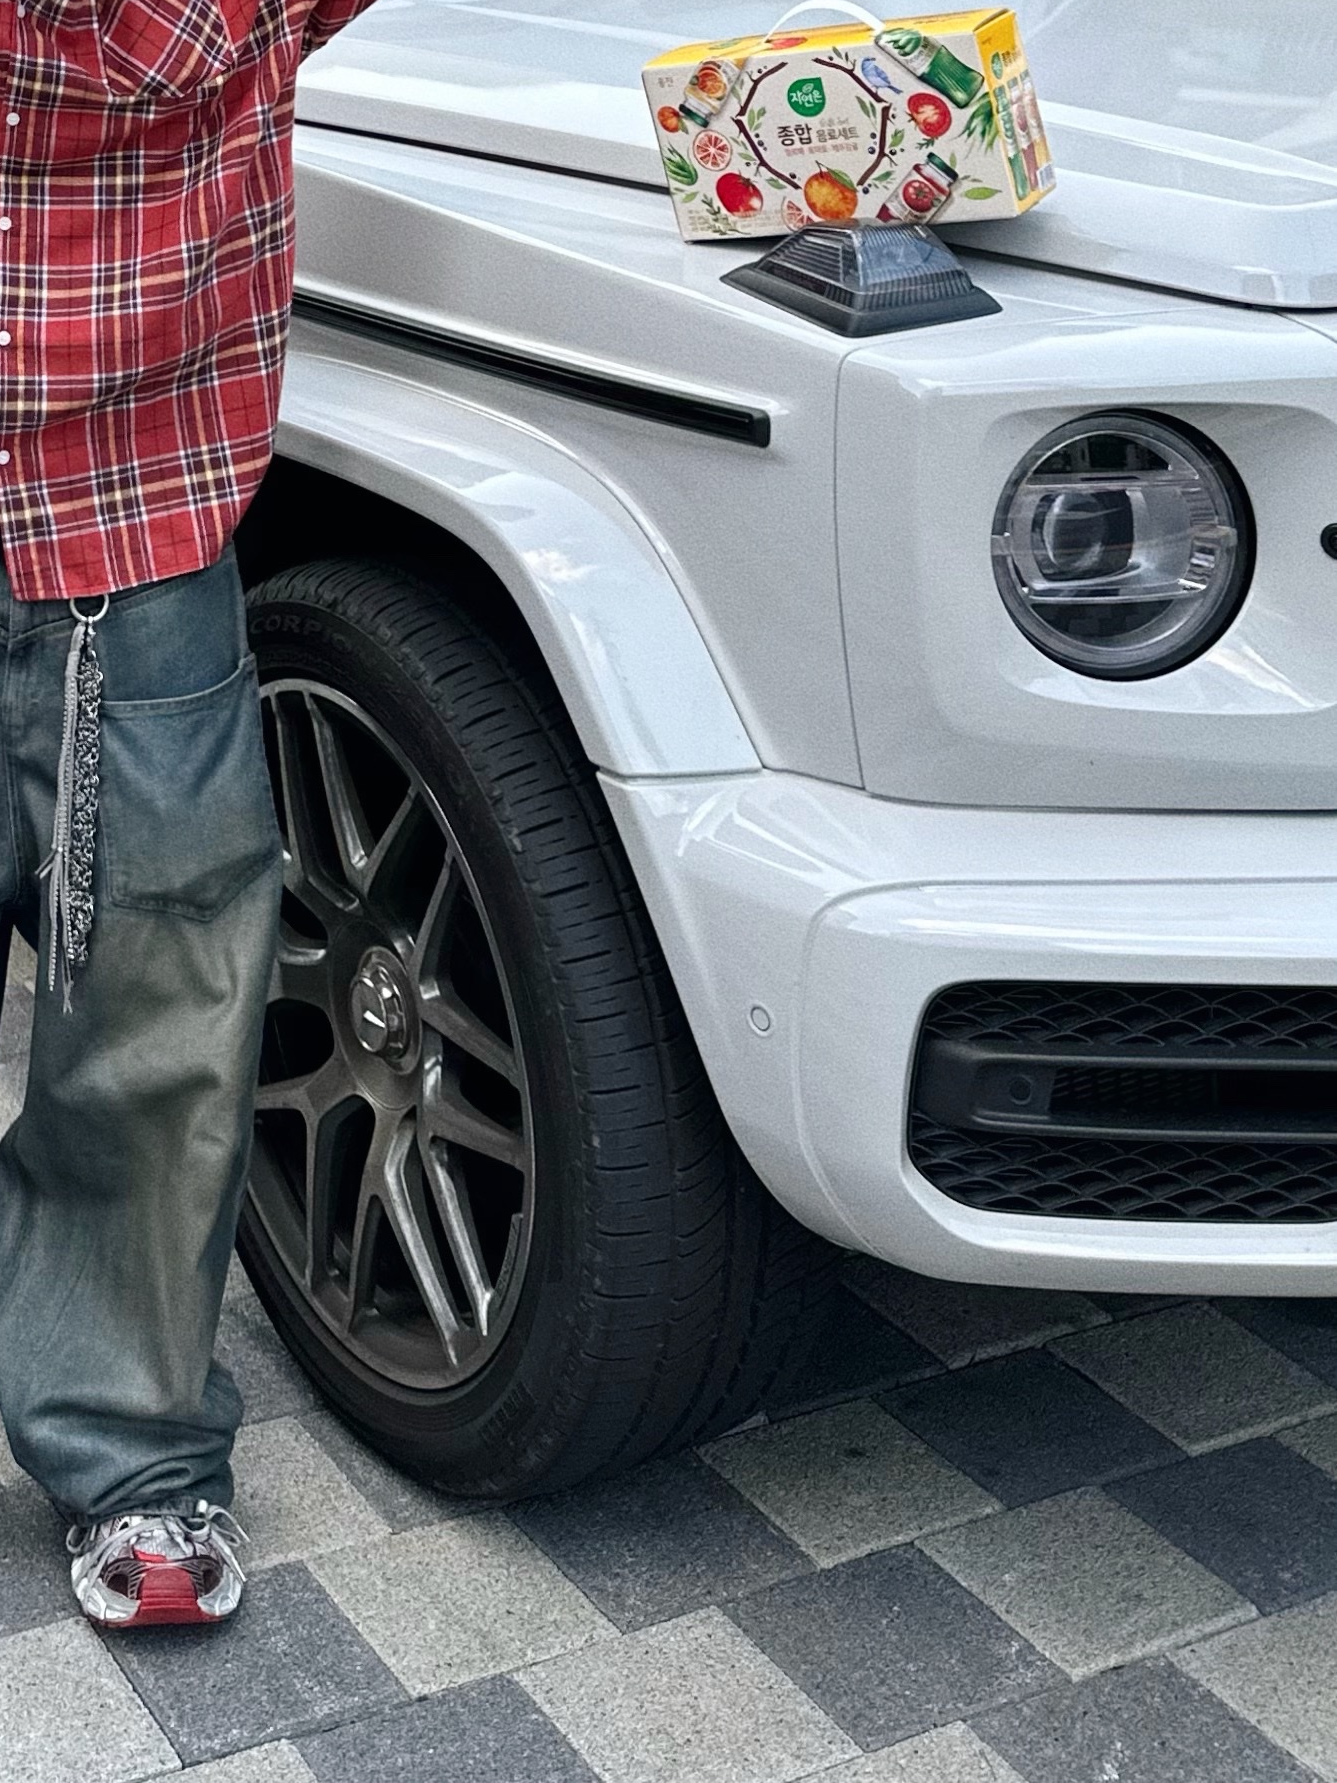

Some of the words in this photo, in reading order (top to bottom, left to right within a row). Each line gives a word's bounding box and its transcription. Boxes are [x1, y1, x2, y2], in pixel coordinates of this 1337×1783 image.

[789, 89, 823, 108] 자연은
[776, 122, 813, 147] 종합
[815, 126, 860, 144] 음료세트
